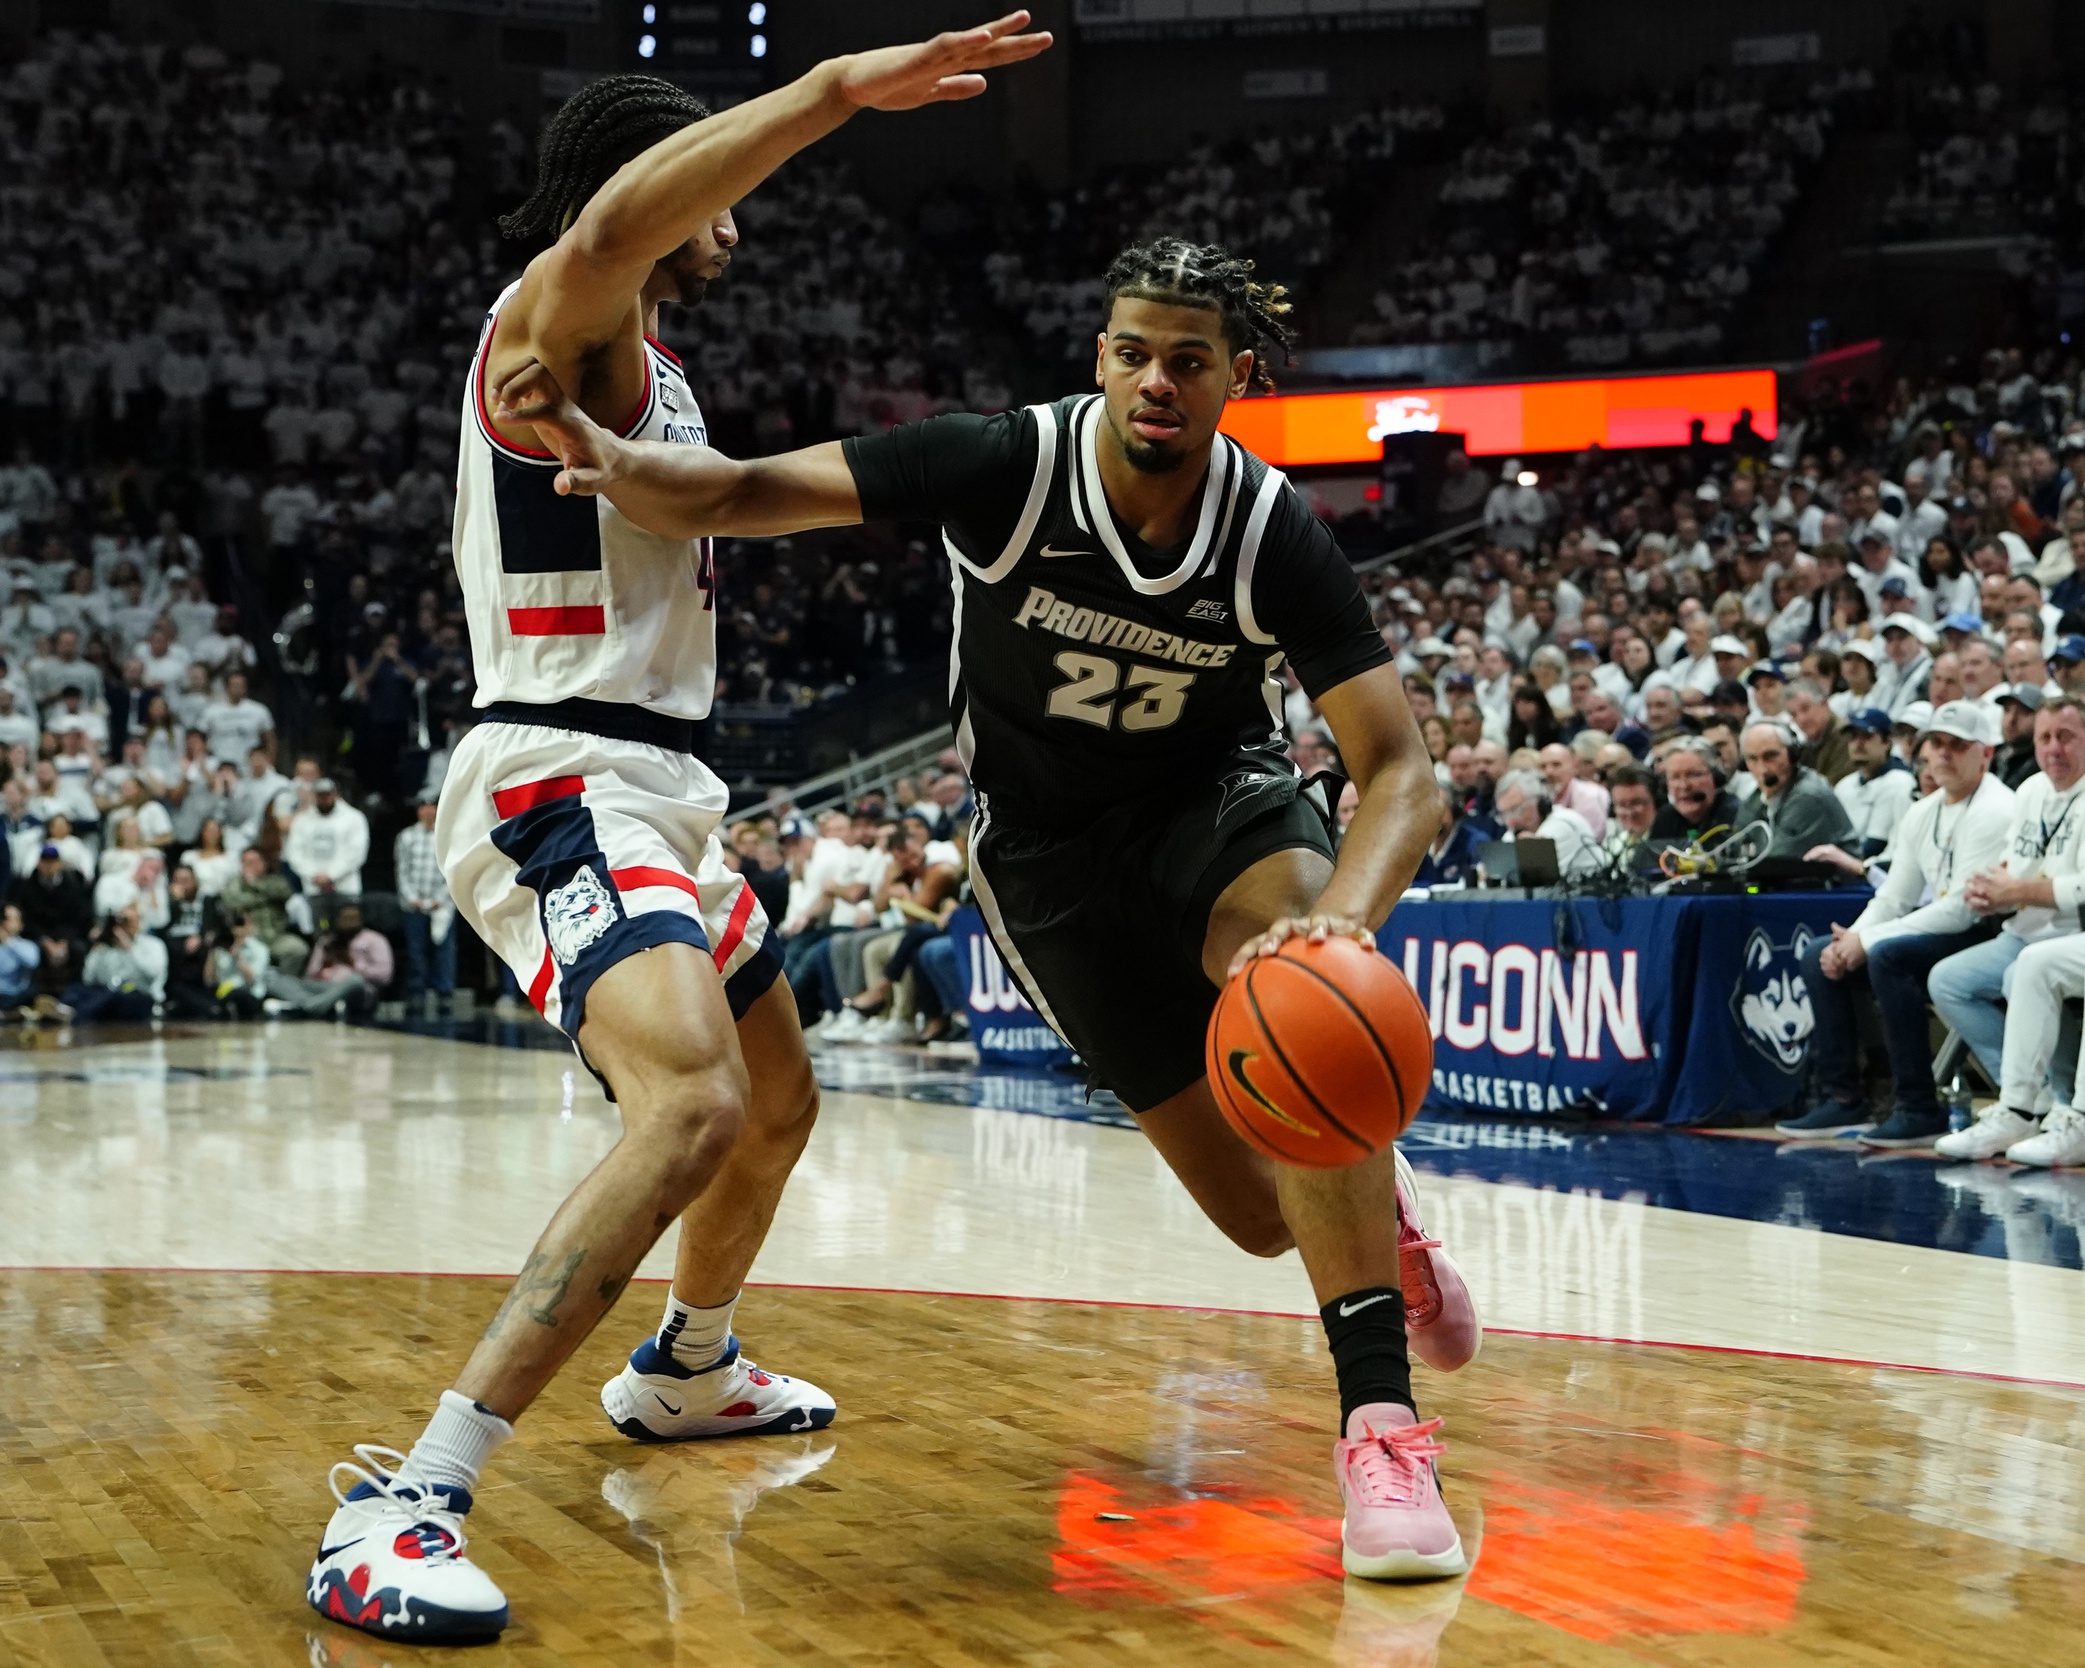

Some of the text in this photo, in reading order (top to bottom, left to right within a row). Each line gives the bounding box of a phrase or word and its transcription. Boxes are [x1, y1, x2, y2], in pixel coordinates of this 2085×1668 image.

[1012, 586, 1237, 667] PROVIDENCE
[1187, 606, 1229, 620] EAST
[1193, 599, 1225, 610] BIG
[1045, 650, 1197, 732] 23
[1404, 936, 1648, 1060] UCONN
